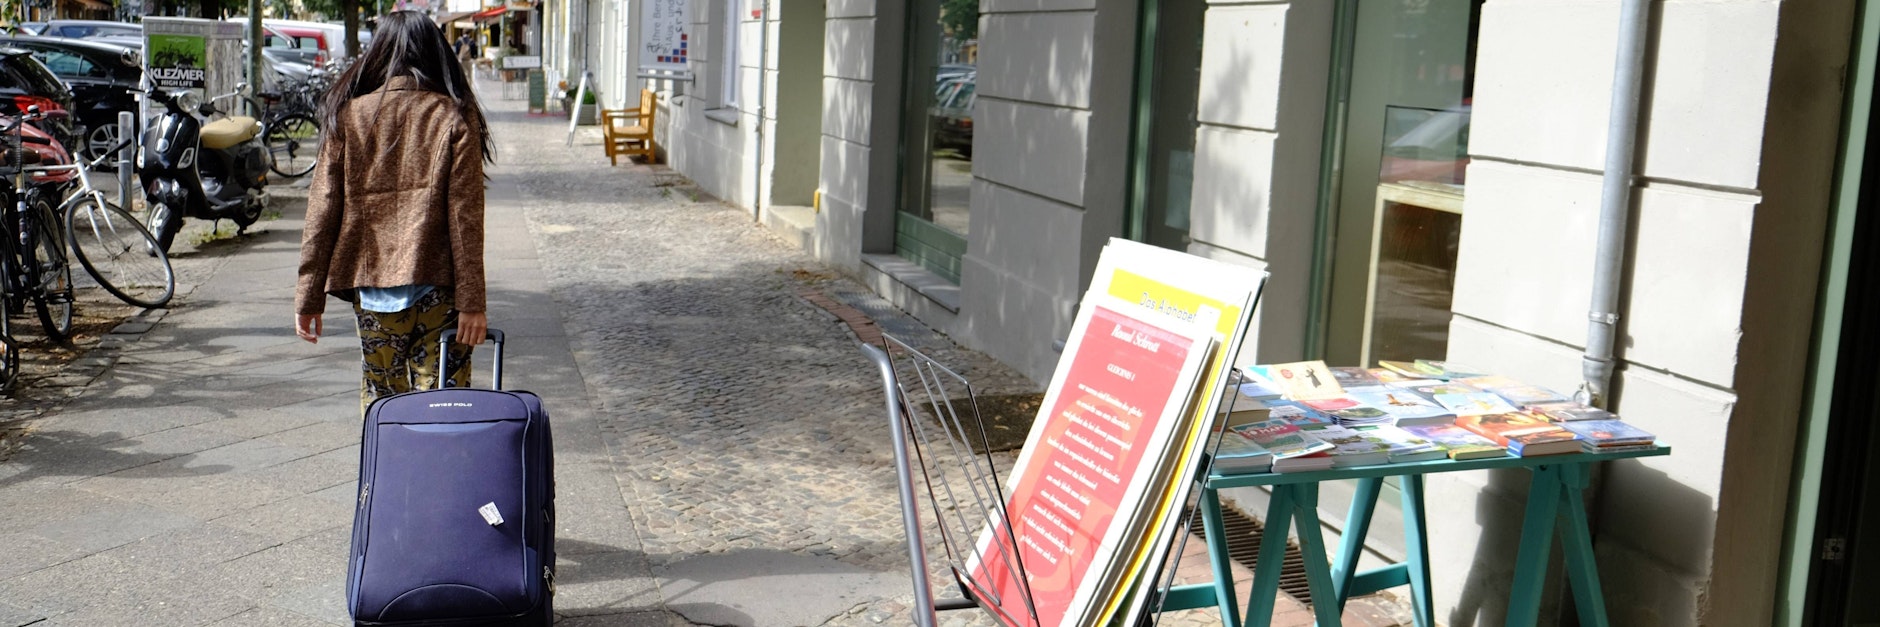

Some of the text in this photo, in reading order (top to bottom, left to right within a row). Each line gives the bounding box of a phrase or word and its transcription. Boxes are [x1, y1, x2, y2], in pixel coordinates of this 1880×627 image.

[150, 66, 204, 80] KLEZMER
[1139, 291, 1197, 324] Das Alphabet
